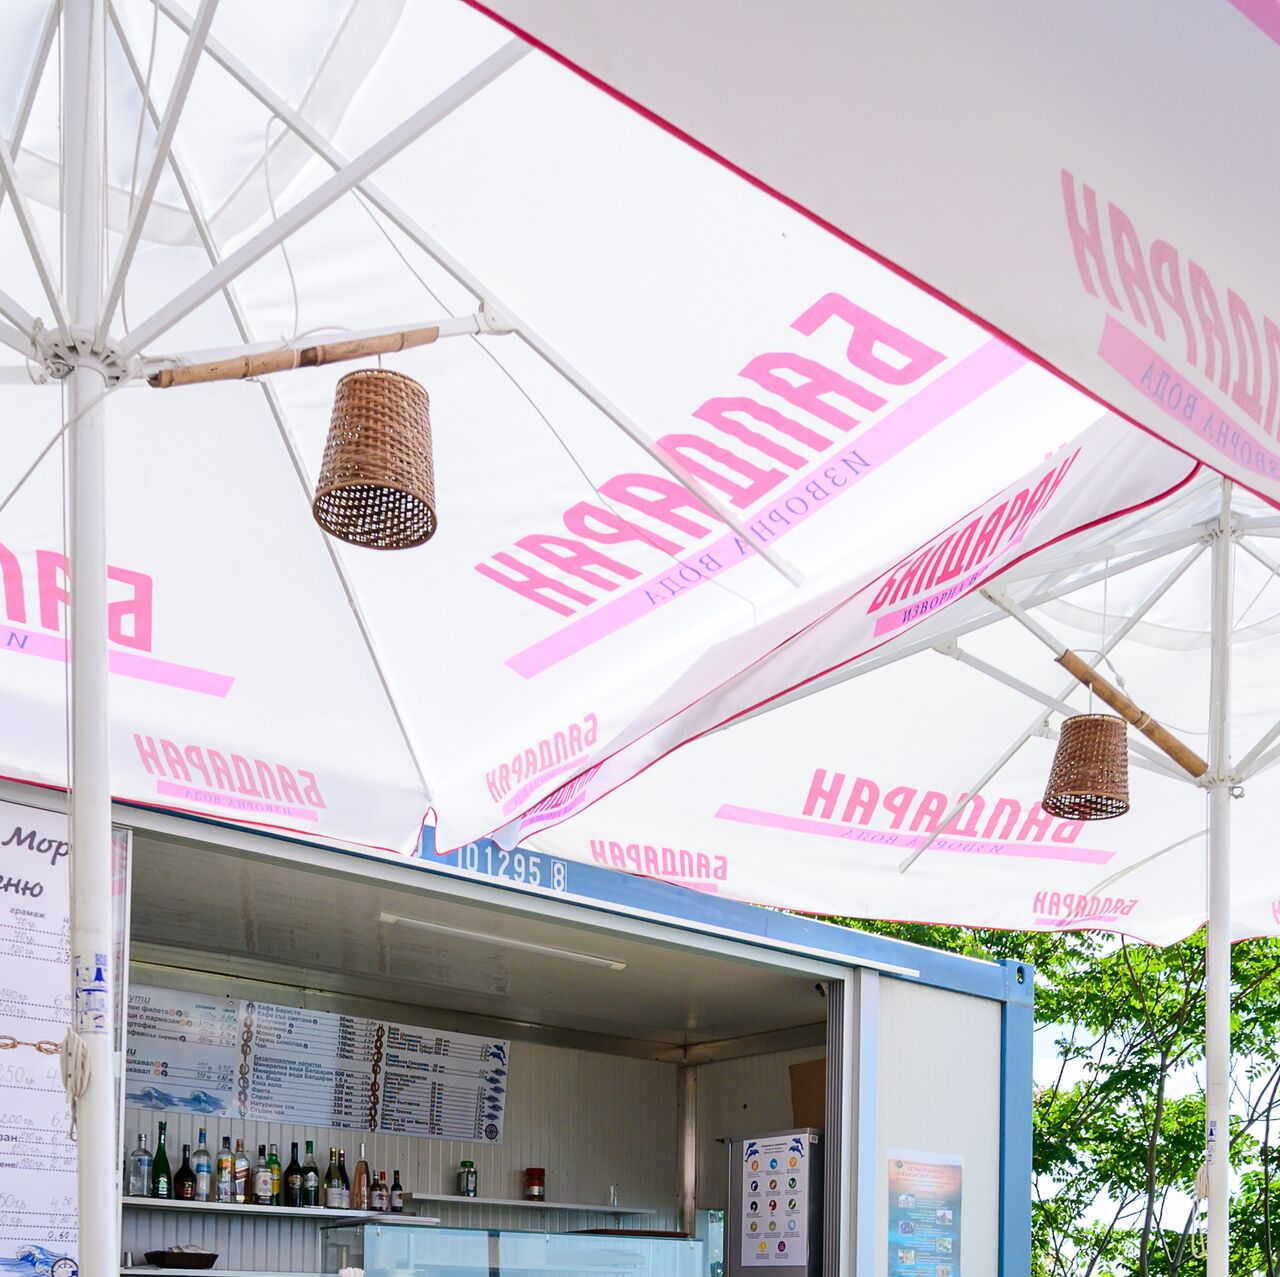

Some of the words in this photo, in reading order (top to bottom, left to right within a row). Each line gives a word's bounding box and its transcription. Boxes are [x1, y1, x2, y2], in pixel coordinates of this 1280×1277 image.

[1, 827, 70, 865] Мор
[553, 862, 566, 891] 8
[9, 907, 45, 920] грамаж
